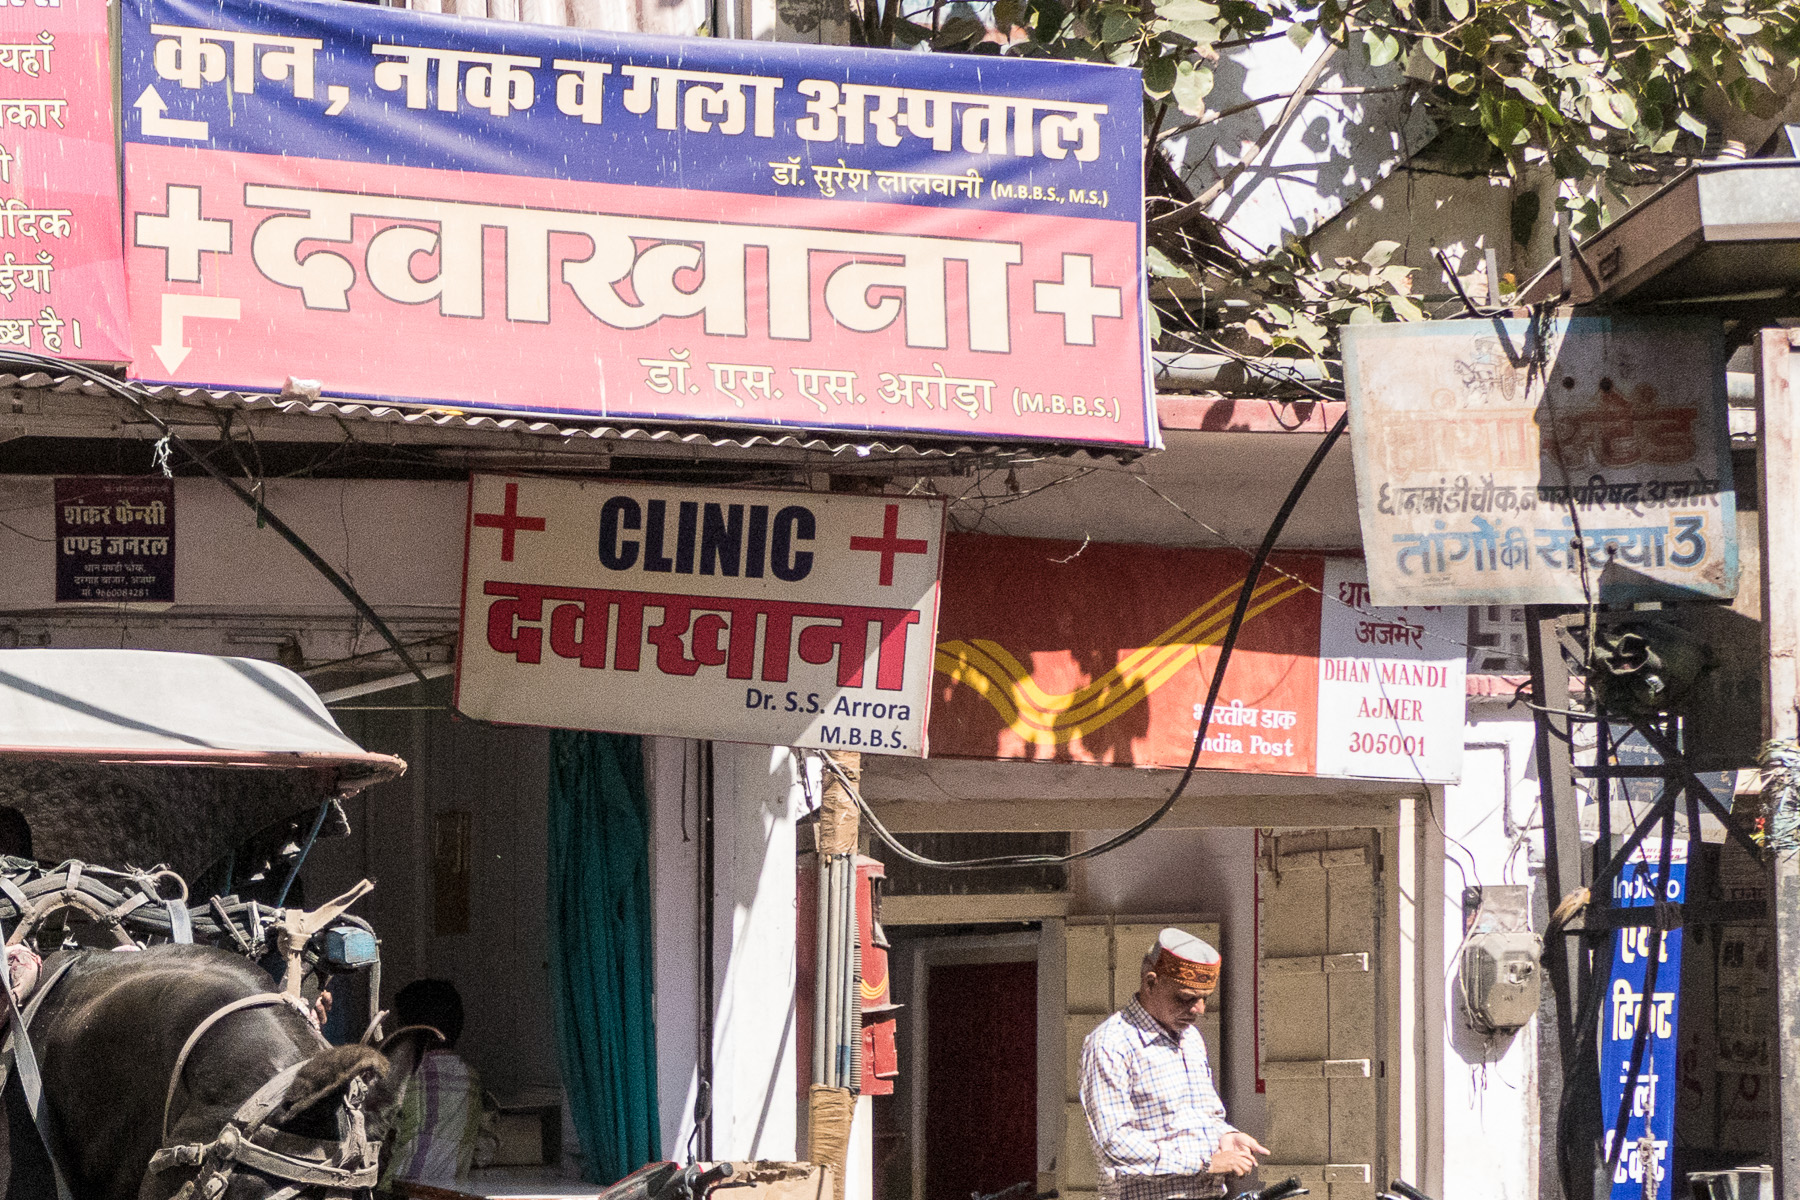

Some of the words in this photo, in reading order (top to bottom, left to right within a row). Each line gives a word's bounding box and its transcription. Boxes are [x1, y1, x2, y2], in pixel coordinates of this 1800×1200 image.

[150, 23, 351, 117] कान,
[371, 43, 542, 117] नाक
[553, 58, 613, 126] व
[621, 64, 784, 138] गला
[796, 78, 1108, 163] अस्पताल
[771, 156, 805, 187] डॉ.
[813, 158, 872, 197] सुरेश
[876, 168, 984, 200] लालवानी
[990, 179, 1065, 204] (M.B.B.S.,
[1068, 186, 1109, 208] M.S.)
[243, 181, 1023, 356] दवाखाना
[638, 348, 700, 397] डॉ.
[709, 362, 784, 408] एस.
[791, 368, 866, 414] एस.
[877, 362, 997, 422] अरोड़ा
[1012, 386, 1122, 422] (M.B.B.S.)
[598, 496, 816, 582] CLINIC
[1669, 515, 1706, 568] 3
[484, 581, 920, 691] दवाखाना
[1355, 617, 1424, 650] अजमेर
[1324, 659, 1370, 683] DHAN
[1381, 662, 1448, 688] MANDI
[746, 688, 777, 711] Dr.
[784, 692, 825, 716] S.S.
[834, 696, 911, 721] Arrora
[1260, 707, 1297, 730] डाक
[1357, 697, 1424, 722] AJMER
[820, 726, 909, 750] M.B.B.S.
[1250, 735, 1294, 757] Post
[1349, 732, 1425, 757] 305001
